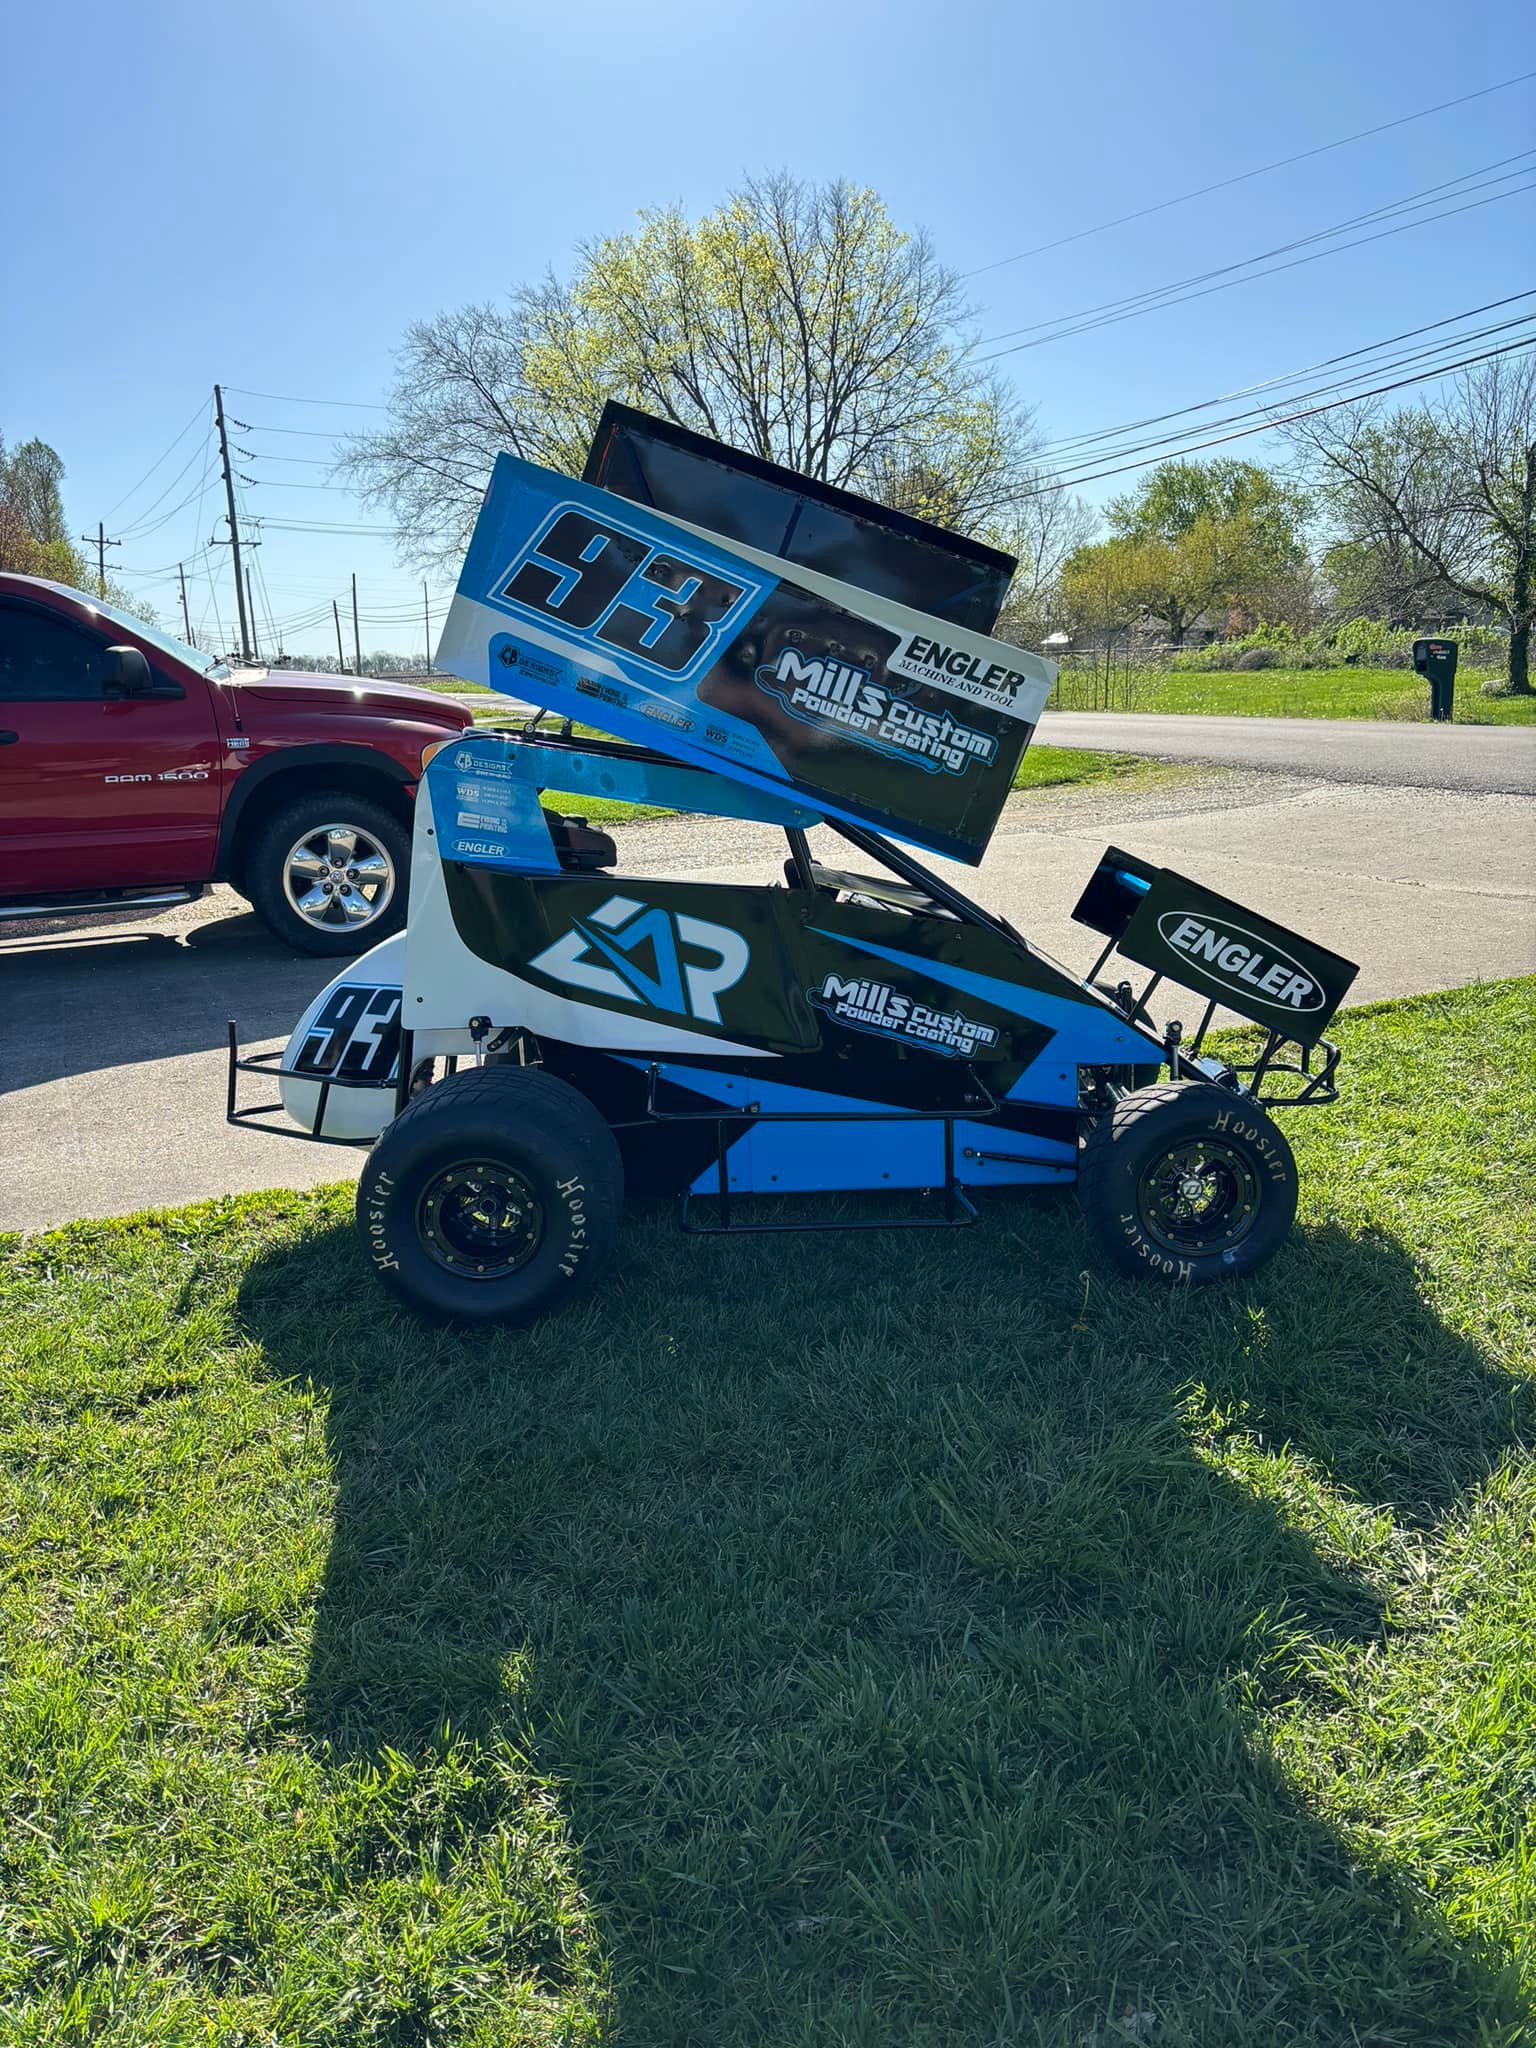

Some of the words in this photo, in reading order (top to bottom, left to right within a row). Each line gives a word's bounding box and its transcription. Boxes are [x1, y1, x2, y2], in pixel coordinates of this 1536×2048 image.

[501, 509, 747, 673] 93
[520, 658, 556, 677] DESIGNS
[899, 659, 955, 687] MACHINE
[957, 682, 983, 697] AND
[984, 690, 1014, 709] TOOL
[904, 635, 1025, 698] ENGLER
[643, 704, 692, 731] ENGLER
[705, 728, 728, 743] WDS
[776, 651, 888, 717] Mills
[886, 702, 992, 757] Custom
[791, 687, 878, 732] Powder
[879, 721, 965, 771] Coating
[157, 771, 209, 781] 1500
[457, 786, 480, 797] WDS
[473, 760, 506, 771] DESIGNS
[457, 841, 505, 856] ENGLER
[1168, 917, 1314, 1009] ENGLER
[292, 986, 402, 1080] 93
[822, 976, 911, 1019] Mills
[911, 1006, 995, 1043] Custom
[835, 1001, 904, 1030] Powder
[904, 1021, 975, 1054] Coating
[1207, 1109, 1287, 1182] Hoosier
[366, 1171, 400, 1271] Hoosier
[556, 1176, 590, 1277] Hoosier
[1119, 1213, 1199, 1283] Hoosier
